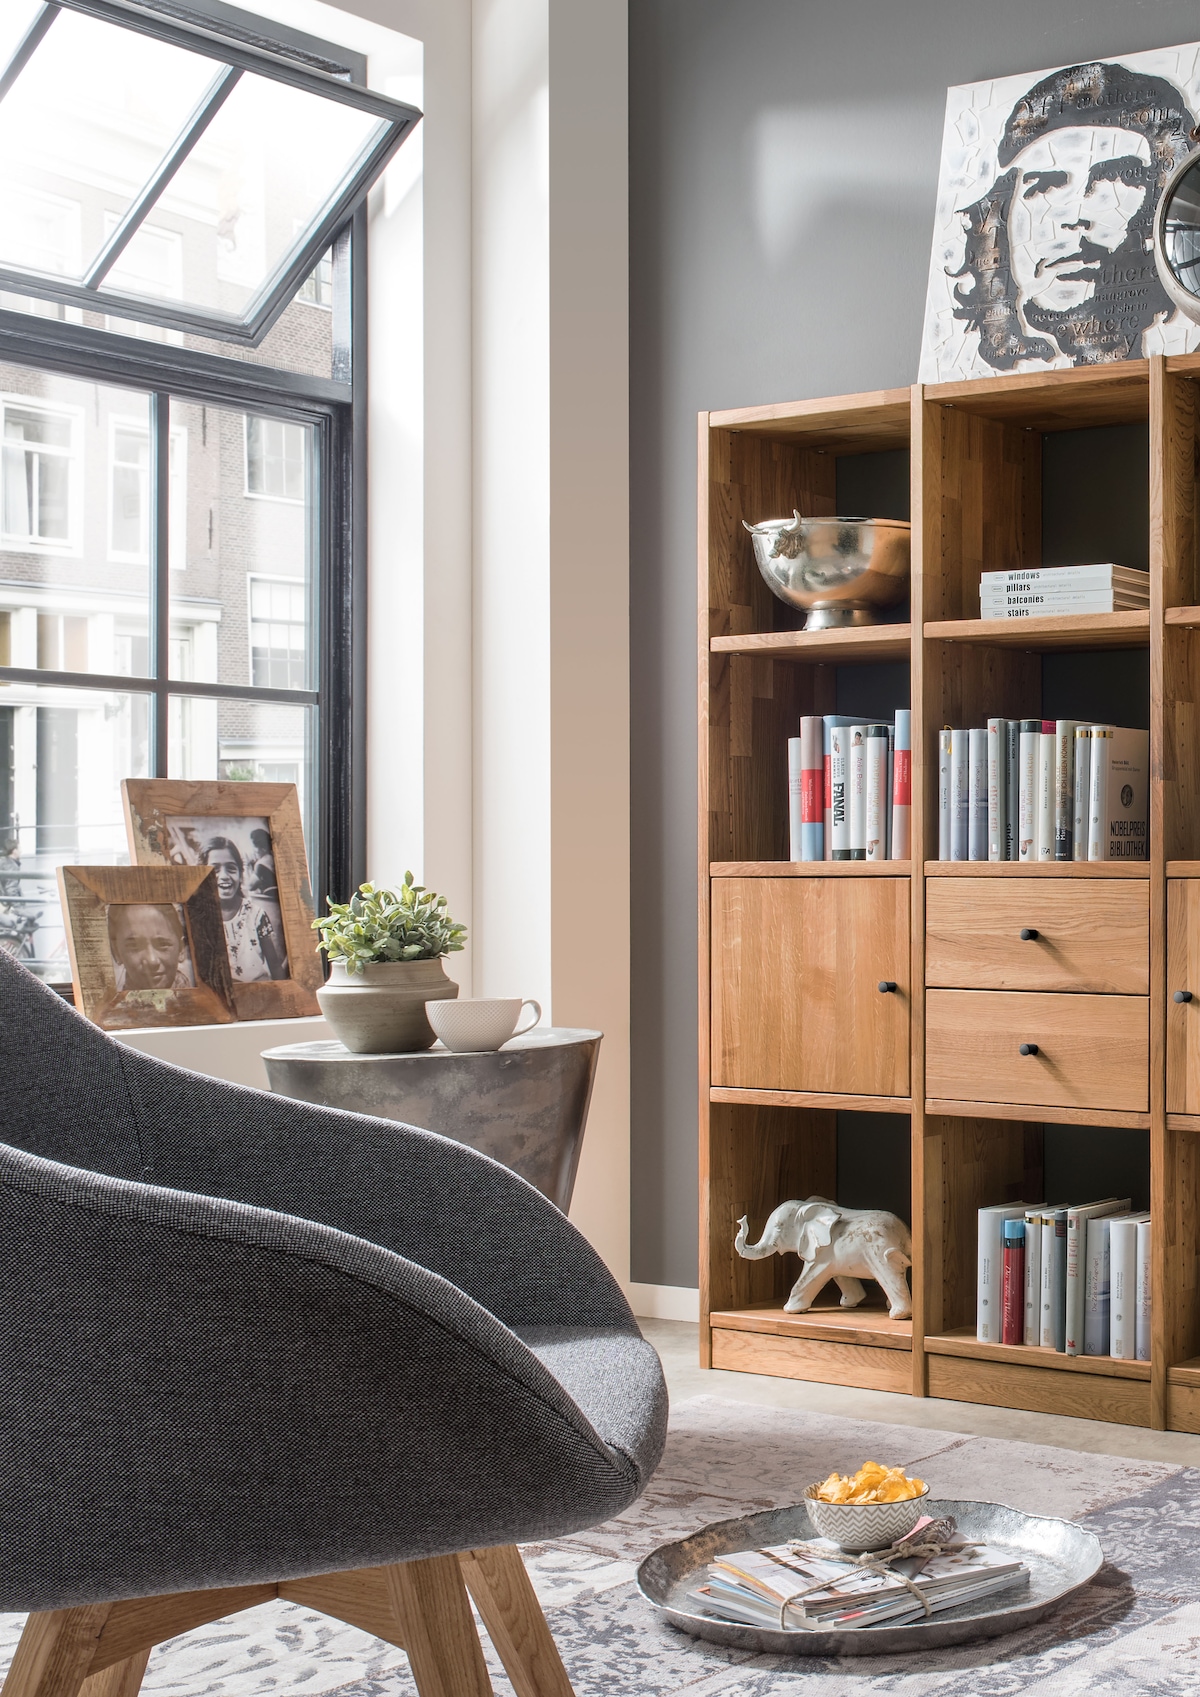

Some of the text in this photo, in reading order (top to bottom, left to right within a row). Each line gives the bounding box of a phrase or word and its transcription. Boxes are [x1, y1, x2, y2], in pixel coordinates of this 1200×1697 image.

[1008, 571, 1040, 581] windows
[1006, 583, 1031, 593] pillars
[1007, 595, 1044, 605] balconies
[1007, 608, 1030, 617] stairs
[1060, 760, 1068, 778] LEBEN
[834, 782, 845, 827] FANAL
[1110, 820, 1146, 837] NOBELPREIS
[1110, 841, 1146, 857] BIBLIOTHEK
